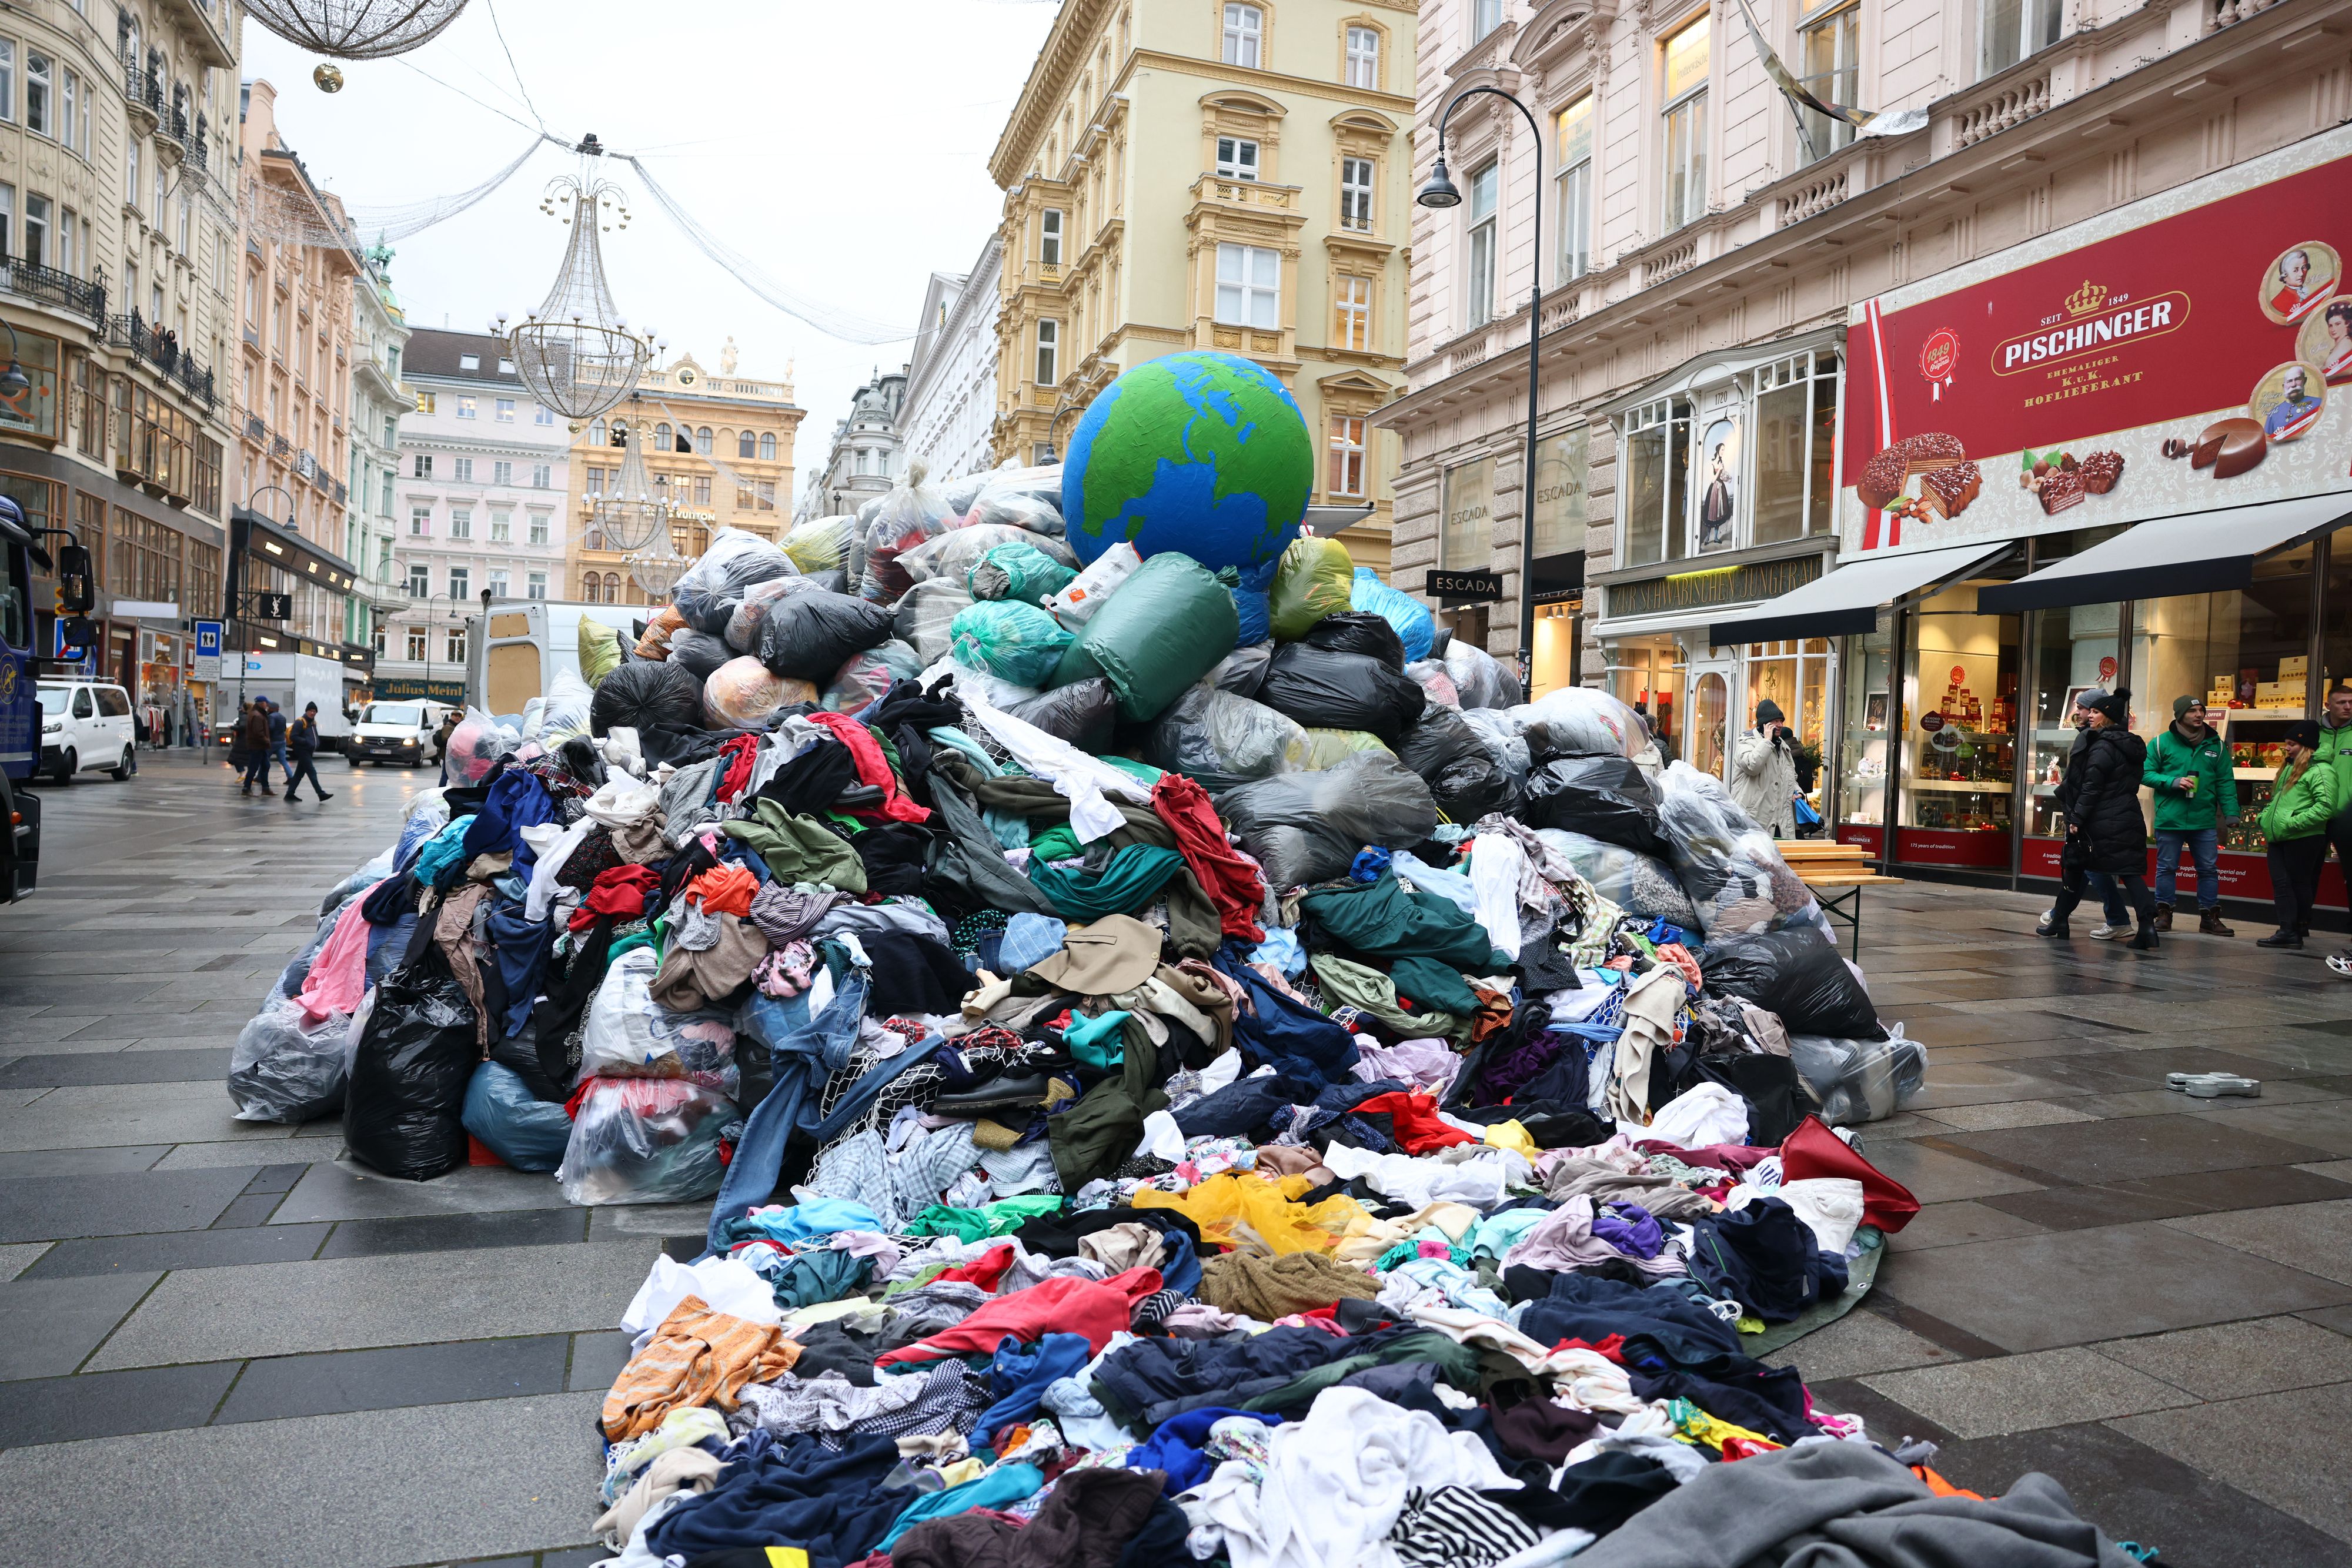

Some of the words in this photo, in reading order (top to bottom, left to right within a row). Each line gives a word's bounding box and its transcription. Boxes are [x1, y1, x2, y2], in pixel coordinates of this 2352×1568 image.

[2040, 313, 2062, 326] SEIT
[2108, 293, 2129, 306] 1849
[2005, 300, 2172, 368] PISCHINGER
[1927, 342, 1950, 363] 1849
[2047, 355, 2119, 379] EHEMALIGER
[1715, 391, 1728, 405] 1720
[2023, 371, 2143, 408] HOFLIEFERANT
[1537, 479, 1582, 503] ESCADA
[676, 510, 716, 521] VUITTON
[1451, 504, 1488, 525] ESCADA
[1436, 577, 1496, 593] ESCADA
[1640, 570, 1735, 611] SCHWÄBISCHEN
[386, 683, 425, 695] Julius
[428, 684, 462, 696] Meinl
[1775, 696, 1789, 704] Jahre
[2218, 875, 2238, 883] bsburgs
